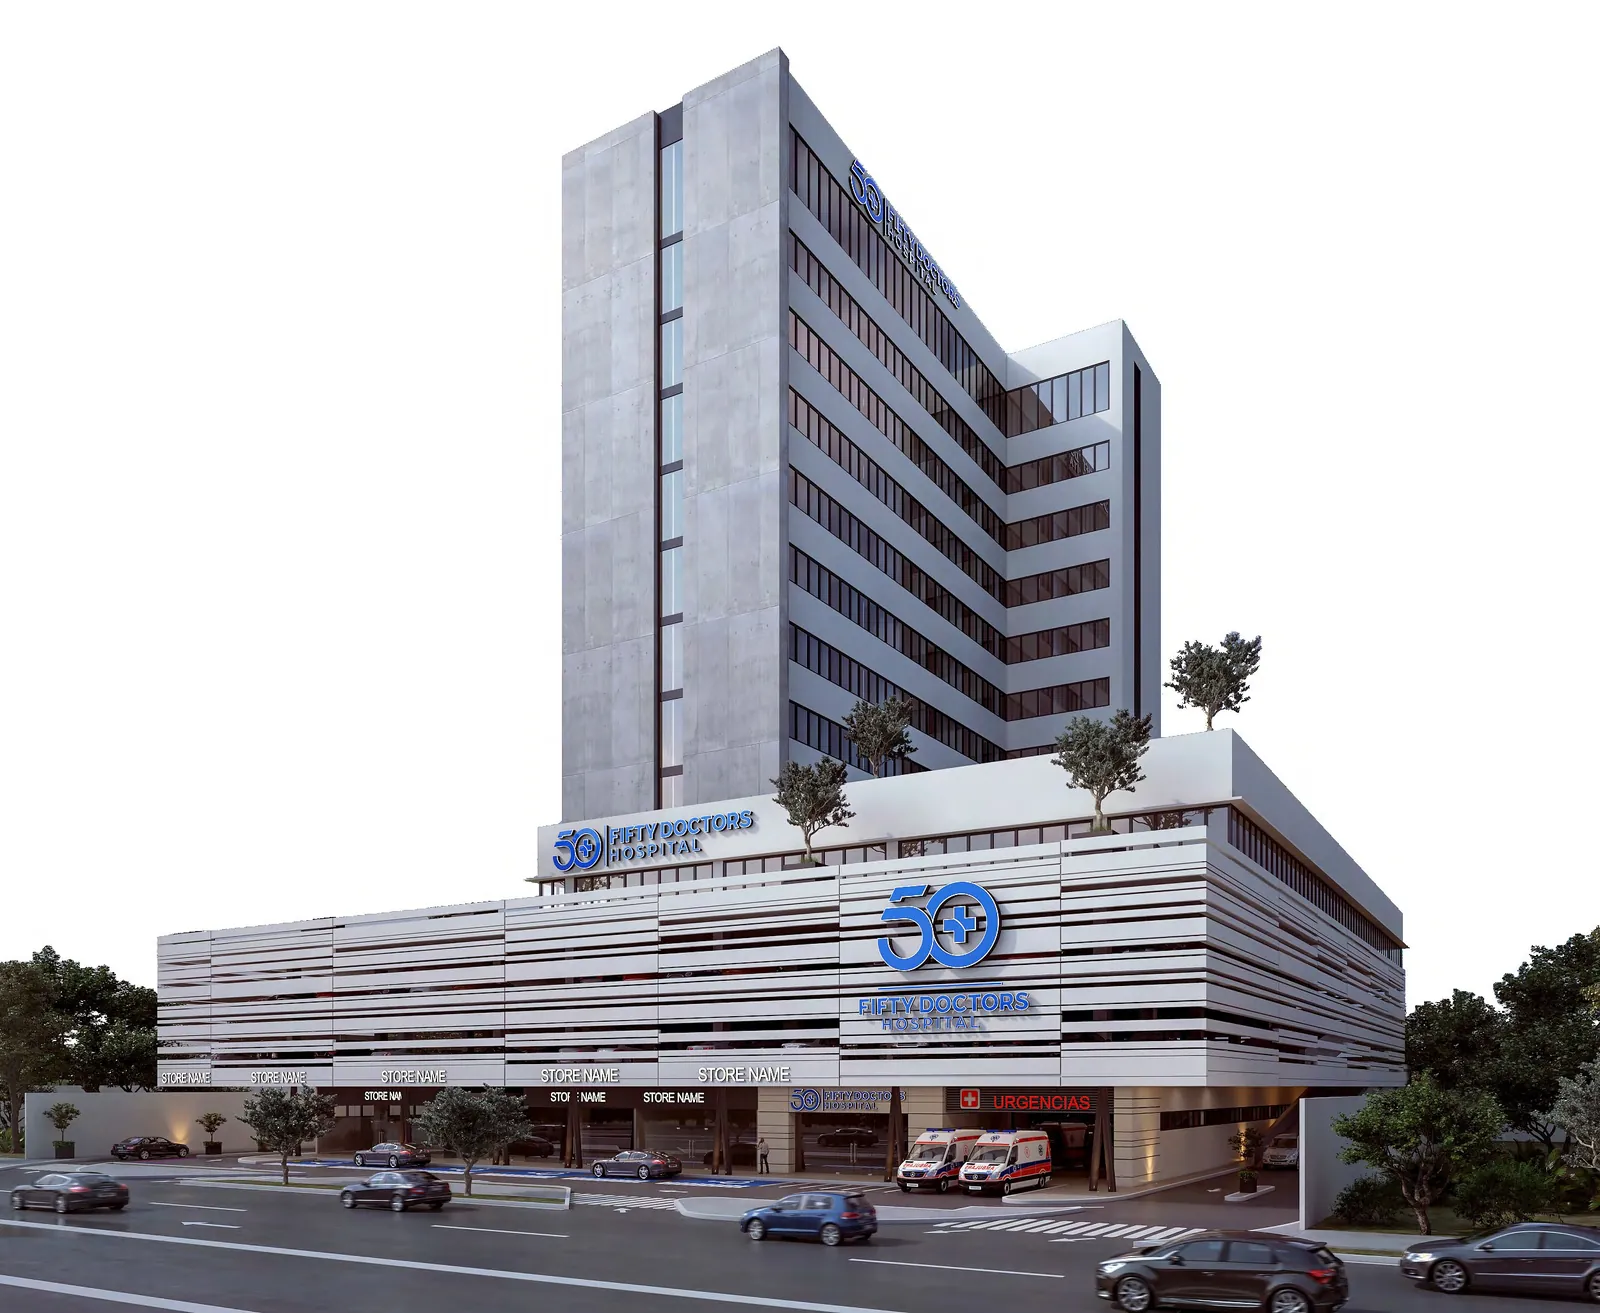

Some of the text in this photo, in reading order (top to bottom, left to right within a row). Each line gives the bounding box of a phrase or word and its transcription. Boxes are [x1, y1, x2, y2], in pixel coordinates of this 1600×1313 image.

[850, 159, 882, 223] 50
[886, 204, 961, 309] FIFTY DOCTORS
[886, 221, 937, 295] HOSPITAL
[609, 810, 752, 845] FIFTY DOCTORS
[552, 827, 603, 871] 50
[609, 838, 702, 862] HOSPITAL
[877, 881, 1000, 971] 50
[858, 992, 1030, 1016] FIFTY DOCTORS
[881, 1015, 981, 1031] HOSPITAL
[161, 1072, 212, 1084] STORE NAME
[250, 1071, 307, 1084] STORE NAME
[381, 1070, 447, 1083] STORE NAME
[541, 1068, 620, 1083] STORE NAME
[698, 1066, 791, 1082] STORE NAME
[364, 1091, 388, 1101] STORE
[580, 1092, 607, 1103] NAME
[643, 1092, 705, 1103] STORE NAME
[790, 1088, 821, 1111] 50
[824, 1091, 906, 1102] FIFTY DOCTOS
[993, 1095, 1091, 1111] URGENCIAS
[824, 1101, 879, 1111] HOSPITAL
